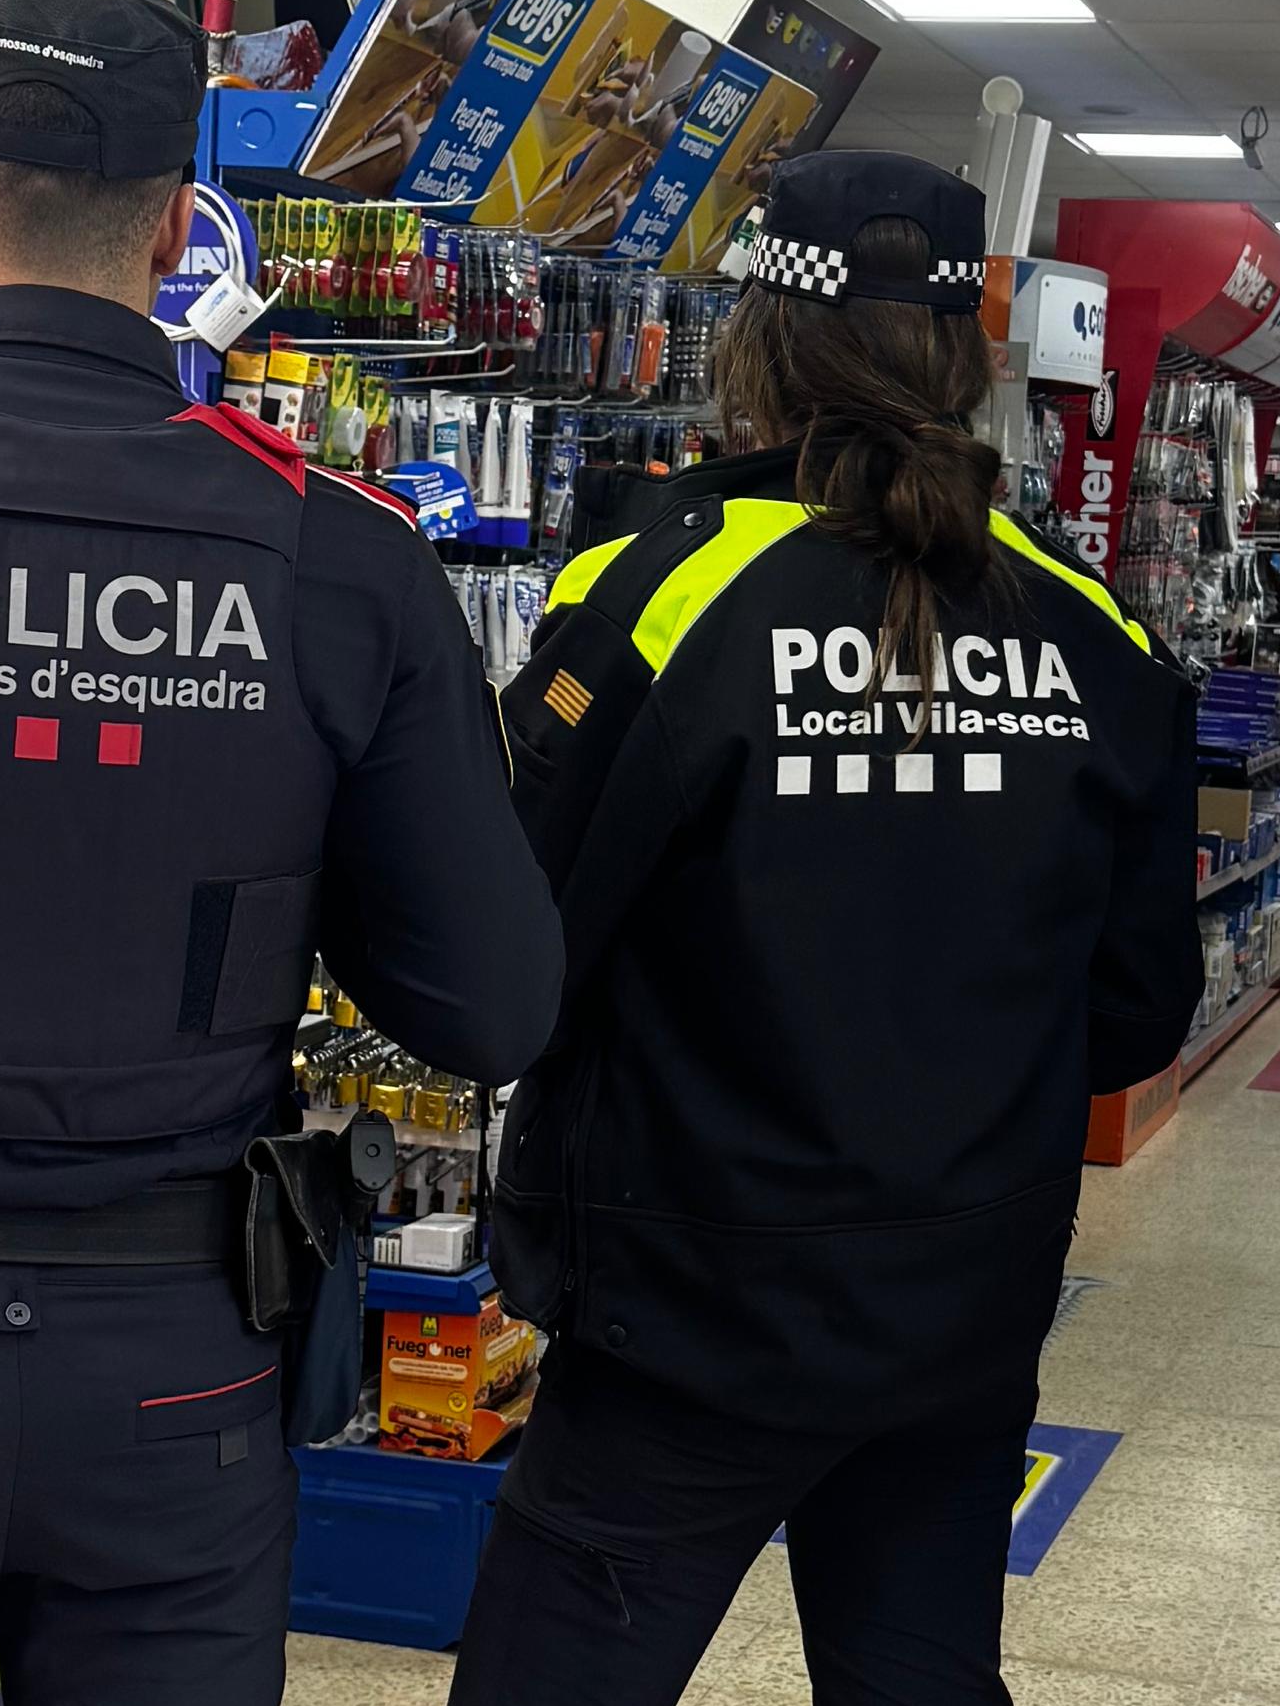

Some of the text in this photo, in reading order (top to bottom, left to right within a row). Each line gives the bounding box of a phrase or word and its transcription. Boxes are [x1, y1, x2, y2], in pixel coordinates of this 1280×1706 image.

[42, 44, 104, 70] d'esquadra
[699, 81, 747, 129] ceys
[177, 282, 193, 293] the
[1075, 450, 1114, 583] cher
[31, 658, 266, 713] d'esquadra
[771, 626, 1082, 705] POLICIA
[775, 701, 1091, 742] Local Vila-seca
